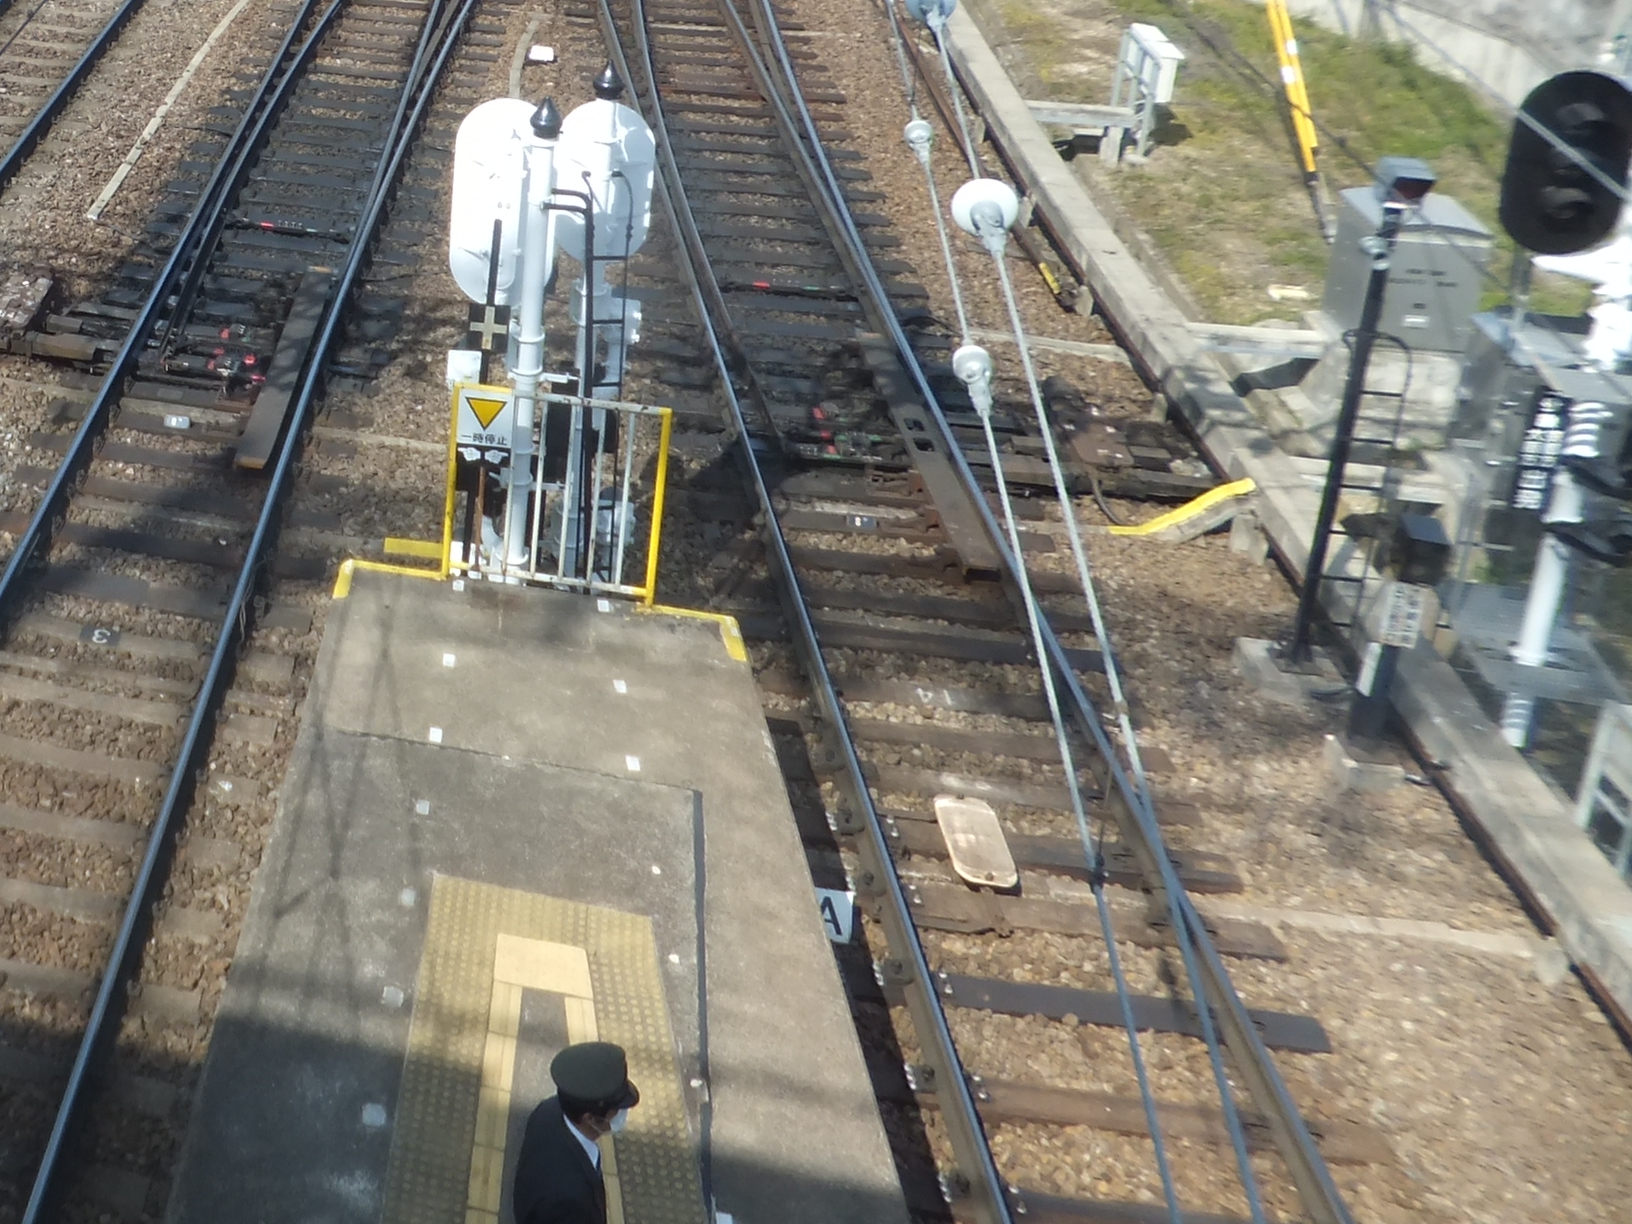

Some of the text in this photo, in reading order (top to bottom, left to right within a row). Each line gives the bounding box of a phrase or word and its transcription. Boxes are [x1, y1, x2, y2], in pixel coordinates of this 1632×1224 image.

[460, 432, 508, 446] 一時停止
[91, 627, 111, 644] 3
[820, 895, 843, 936] A
